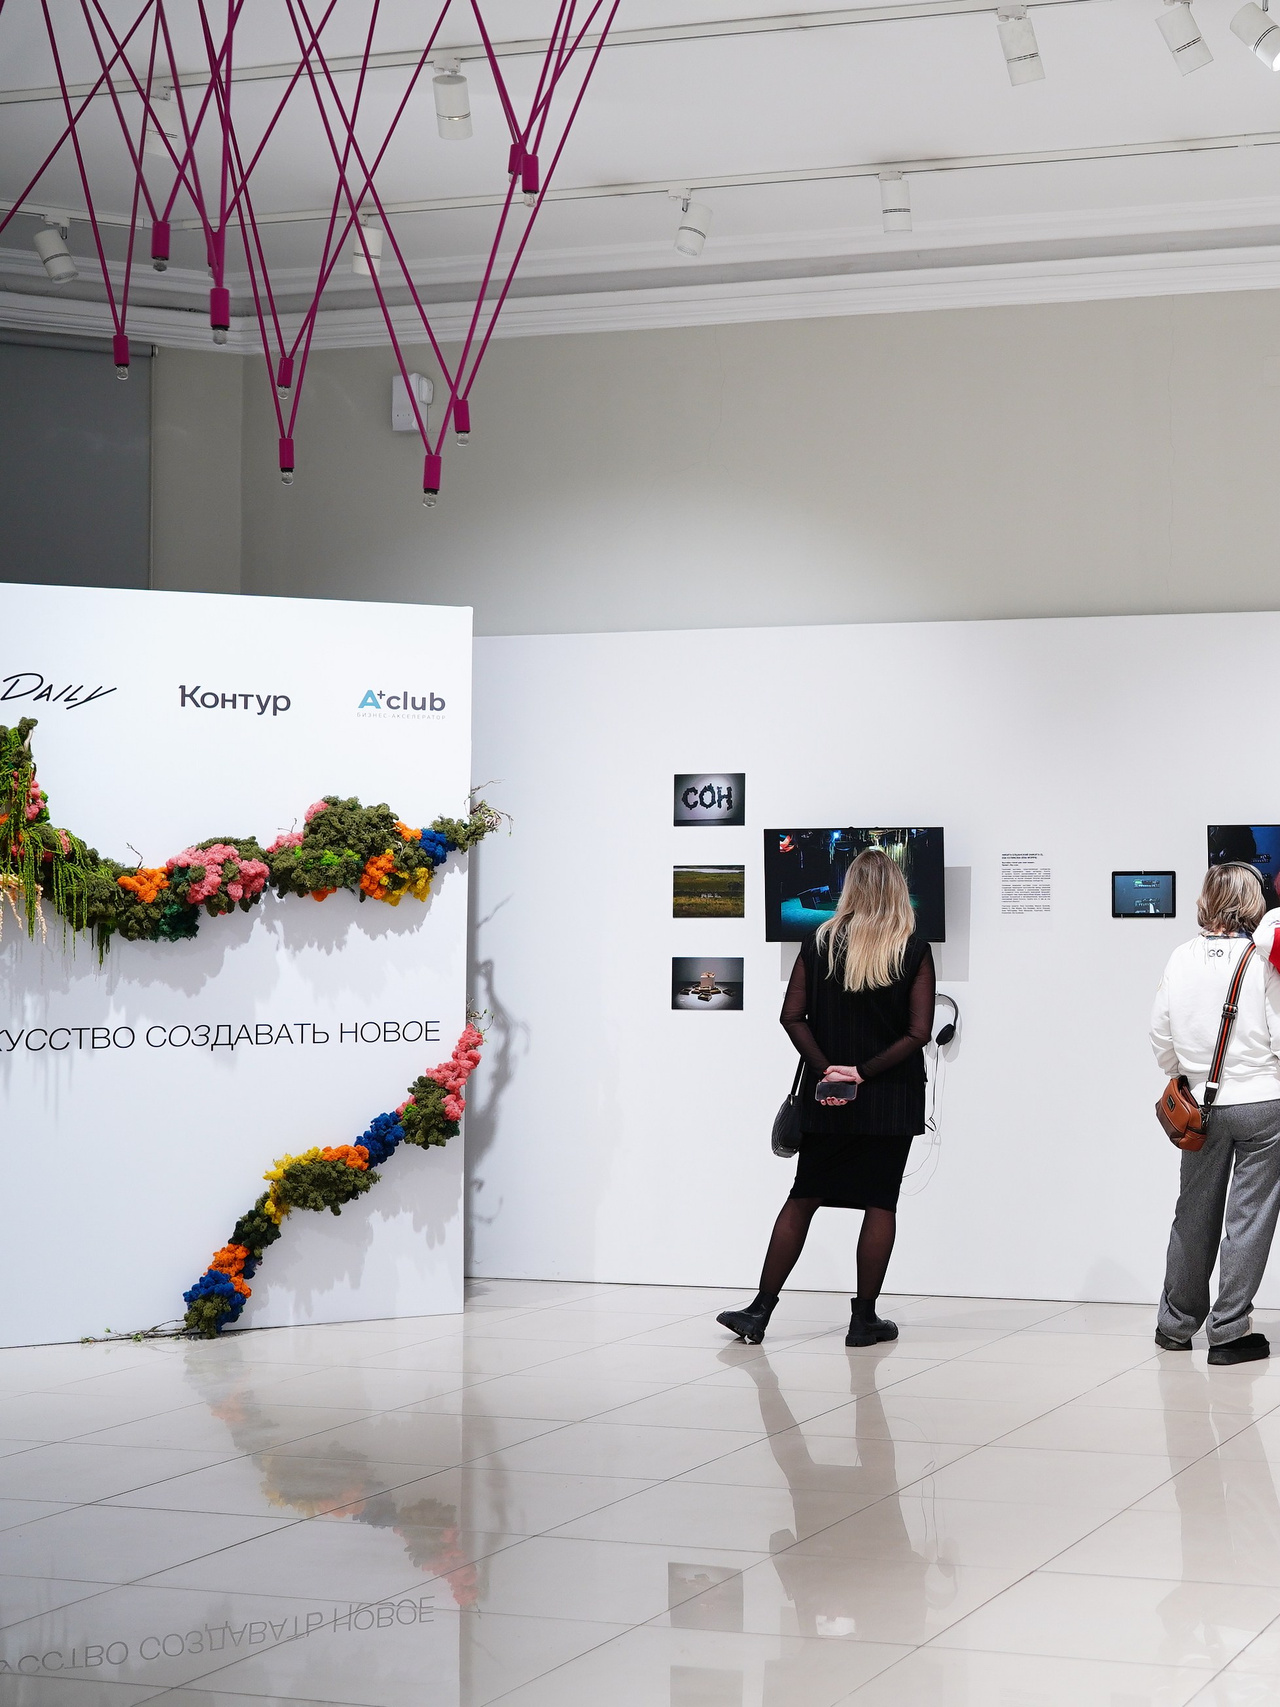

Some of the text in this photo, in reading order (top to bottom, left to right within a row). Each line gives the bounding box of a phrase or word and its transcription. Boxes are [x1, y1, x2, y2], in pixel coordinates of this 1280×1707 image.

[178, 684, 292, 716] Контур
[681, 783, 733, 811] СОН
[0, 1020, 441, 1052] УССТВО СОЗДАВАТЬ НОВОЕ
